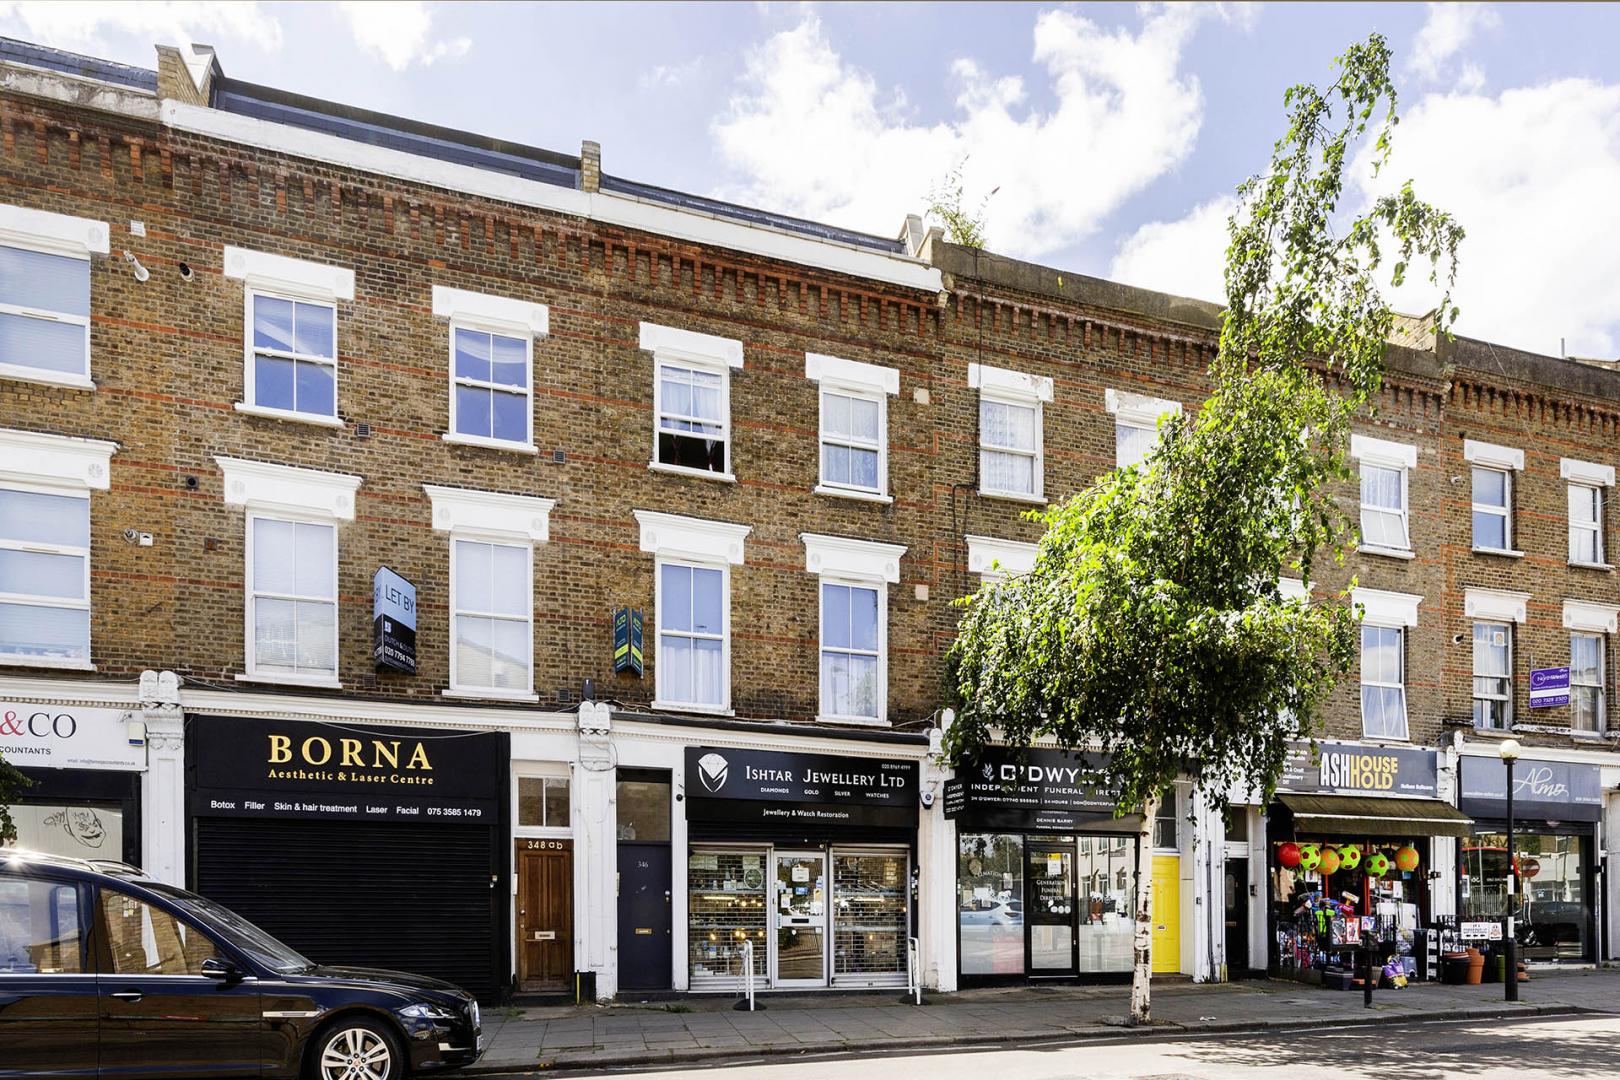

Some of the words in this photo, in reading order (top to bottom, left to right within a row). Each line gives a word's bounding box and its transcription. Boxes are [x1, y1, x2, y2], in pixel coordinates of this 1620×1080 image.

[386, 584, 401, 607] LET
[404, 596, 414, 614] BY
[384, 646, 394, 657] 020
[0, 710, 76, 738] &CO
[268, 735, 432, 770] BORNA
[1320, 752, 1350, 788] ASH
[268, 769, 334, 780] Aesthetic
[338, 772, 346, 781] &
[352, 772, 386, 783] Laser
[390, 775, 434, 784] Centre
[210, 800, 235, 809] Botox
[244, 801, 265, 810] Filler
[274, 802, 292, 811] Skin
[294, 803, 300, 811] &
[302, 803, 318, 811] hair
[319, 804, 357, 813] treatment
[366, 805, 388, 814] Laser
[396, 806, 419, 815] Facial
[443, 808, 462, 816] 3585
[763, 808, 790, 818] Jewellery
